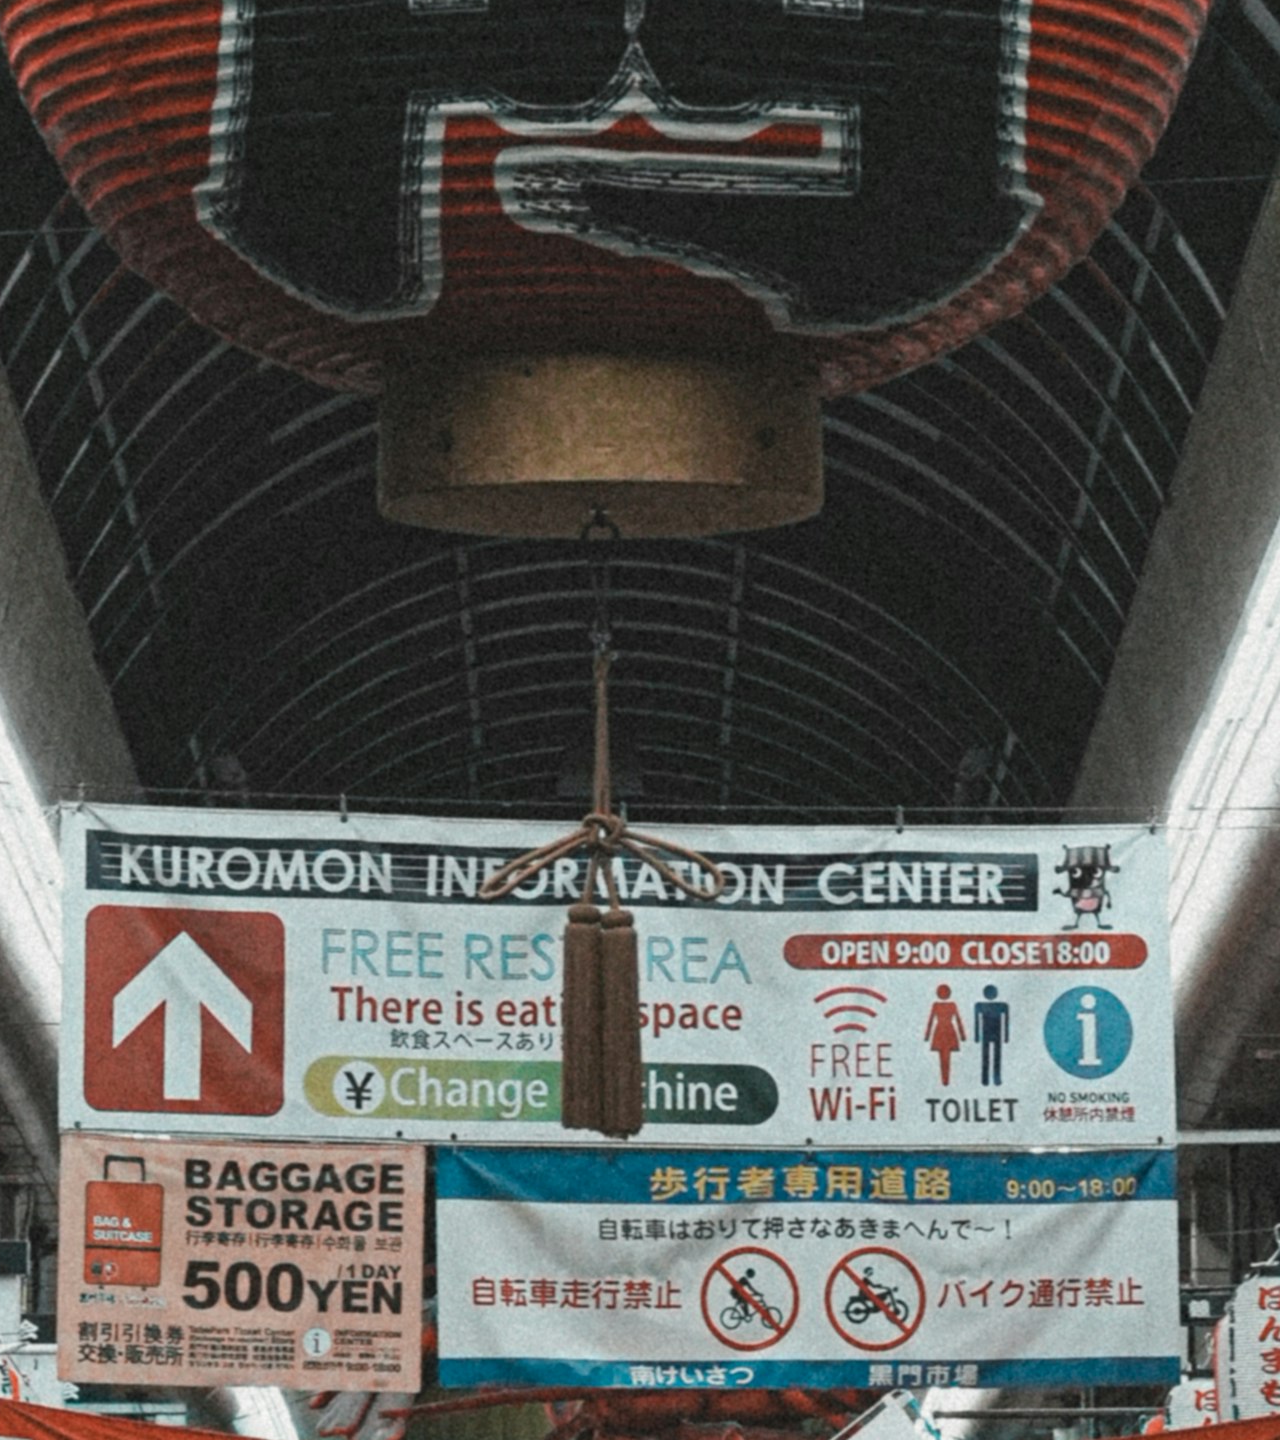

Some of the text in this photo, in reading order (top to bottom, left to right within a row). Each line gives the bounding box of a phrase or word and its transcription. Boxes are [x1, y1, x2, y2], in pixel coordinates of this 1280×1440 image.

[120, 843, 393, 894] KUROMON
[819, 862, 1004, 905] CENTER
[321, 927, 443, 979] FREE
[465, 933, 563, 981] RES
[821, 940, 889, 965] OPEN
[895, 941, 950, 965] 9:00
[330, 986, 442, 1026] There
[455, 990, 482, 1026] is
[637, 1000, 742, 1039] space
[390, 1028, 562, 1052] 飲食スペースあり
[810, 1044, 892, 1078] FREE
[344, 1070, 375, 1109] ¥
[390, 1066, 549, 1118] Change
[809, 1086, 897, 1121] Wi-Fi
[1048, 1093, 1130, 1104] NO SMOKING
[926, 1098, 1018, 1123] TOILET
[1043, 1106, 1135, 1123] 休憩所内禁煙
[185, 1158, 404, 1194] BAGGAGE
[650, 1165, 952, 1201] 歩行者専用道路
[93, 1215, 132, 1228] BAG &
[185, 1196, 404, 1232] STORAGE
[93, 1229, 153, 1243] SUITCASE
[361, 1265, 402, 1280] DAY
[472, 1278, 683, 1310] 自転車走行禁止
[937, 1277, 1145, 1309] バイク通行禁止
[78, 1321, 185, 1344] 割引引換券
[631, 1365, 754, 1386] 南けいさつ
[868, 1366, 979, 1387] 黒門市場
